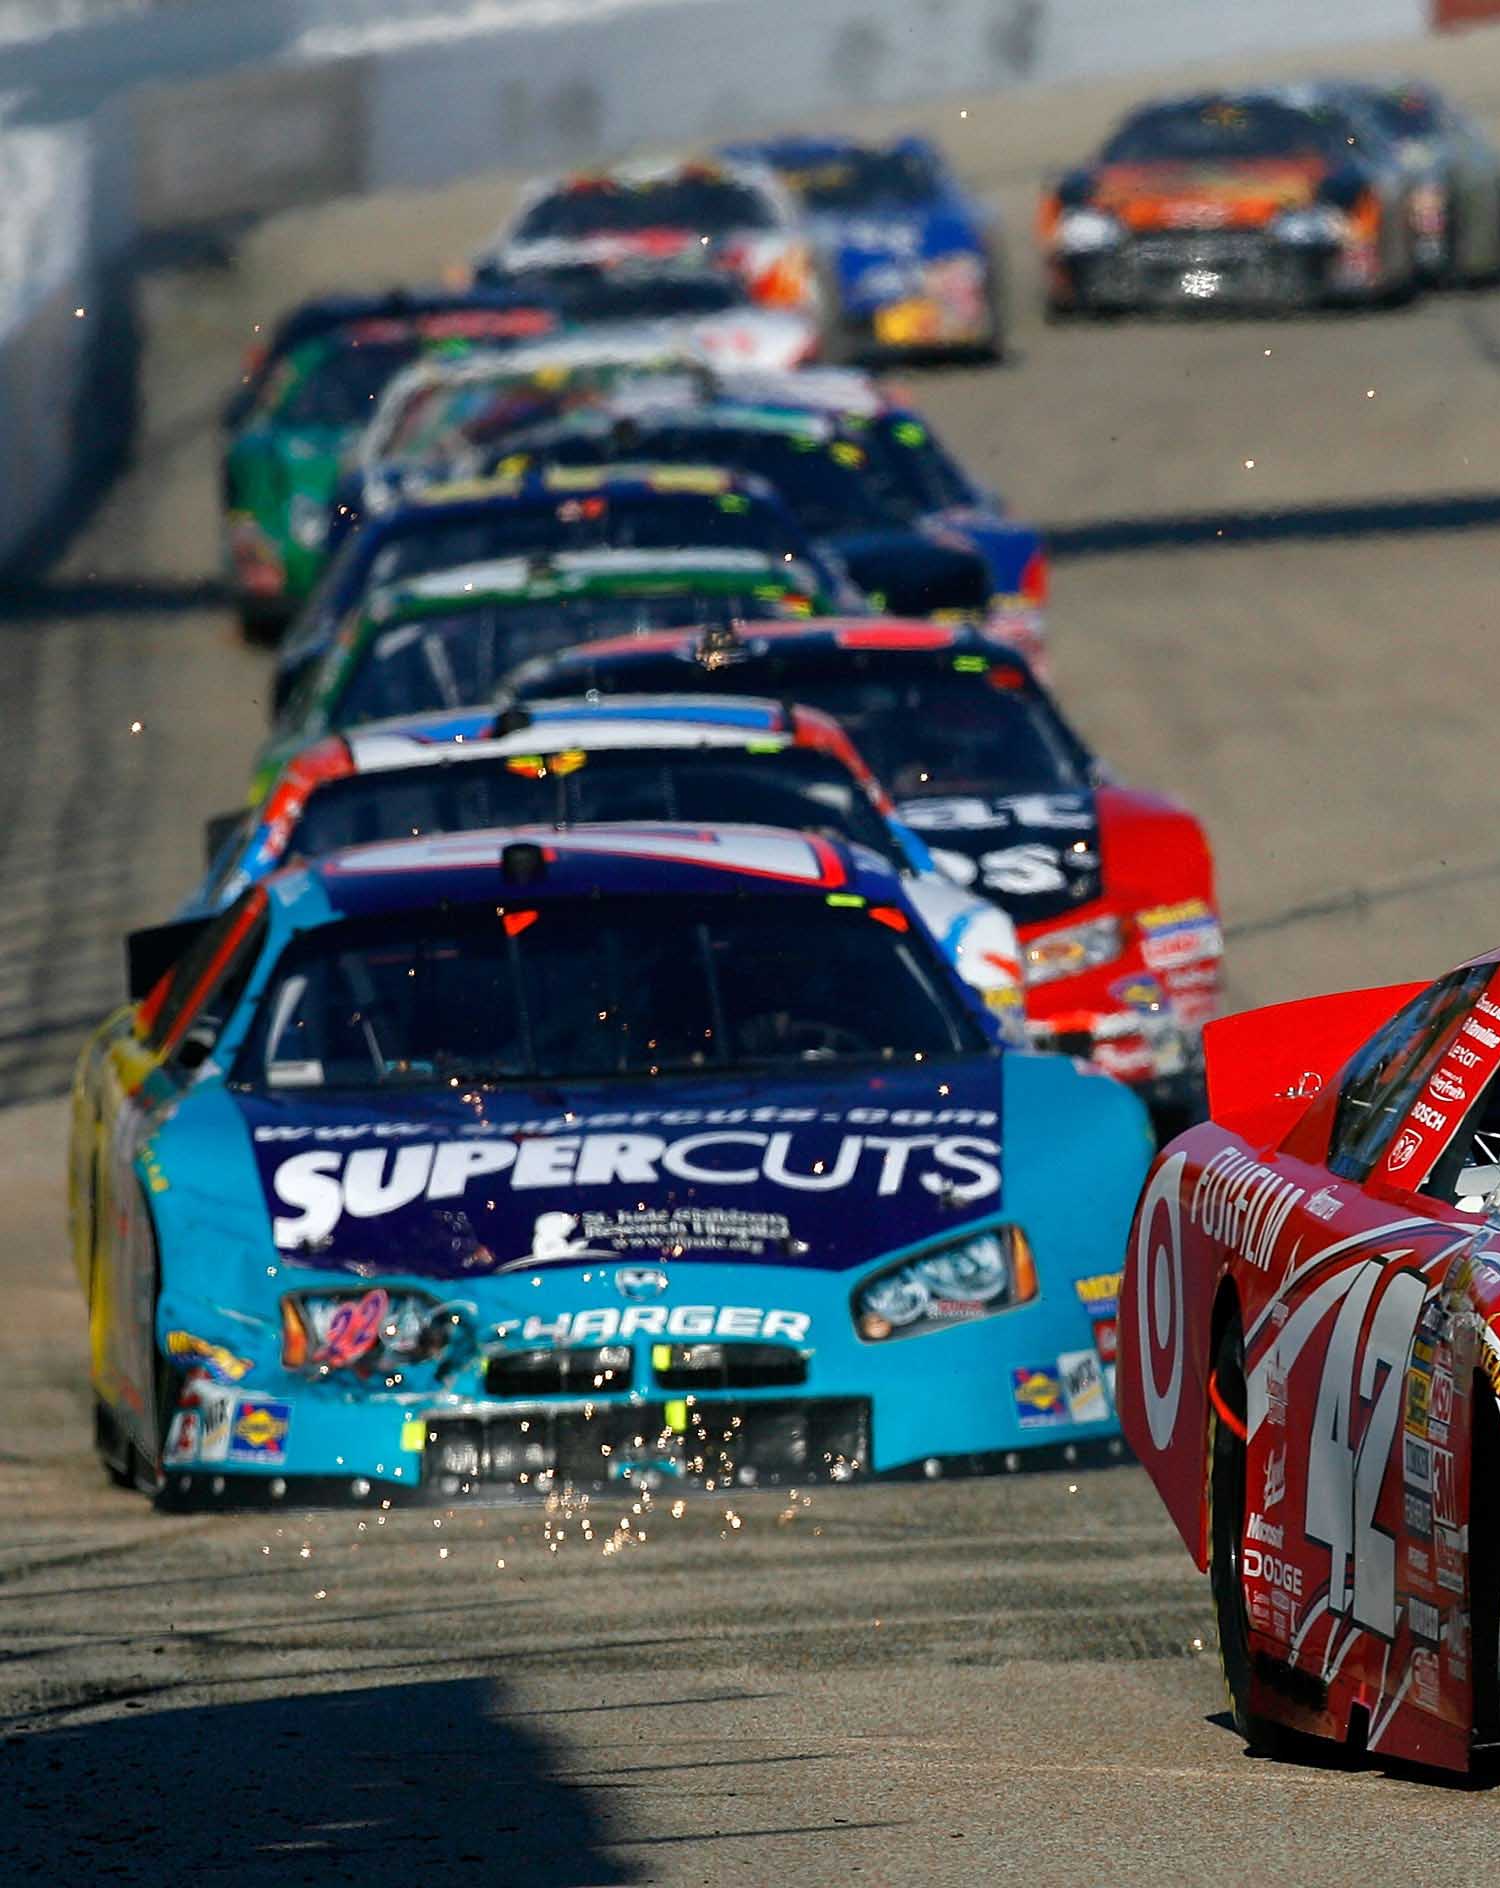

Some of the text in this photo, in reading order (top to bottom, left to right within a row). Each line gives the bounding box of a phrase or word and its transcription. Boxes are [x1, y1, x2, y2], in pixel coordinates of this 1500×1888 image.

[272, 1131, 1002, 1250] SUPERCUTS
[1190, 1146, 1307, 1272] FUJIFILM
[1243, 1548, 1303, 1595] DODGE
